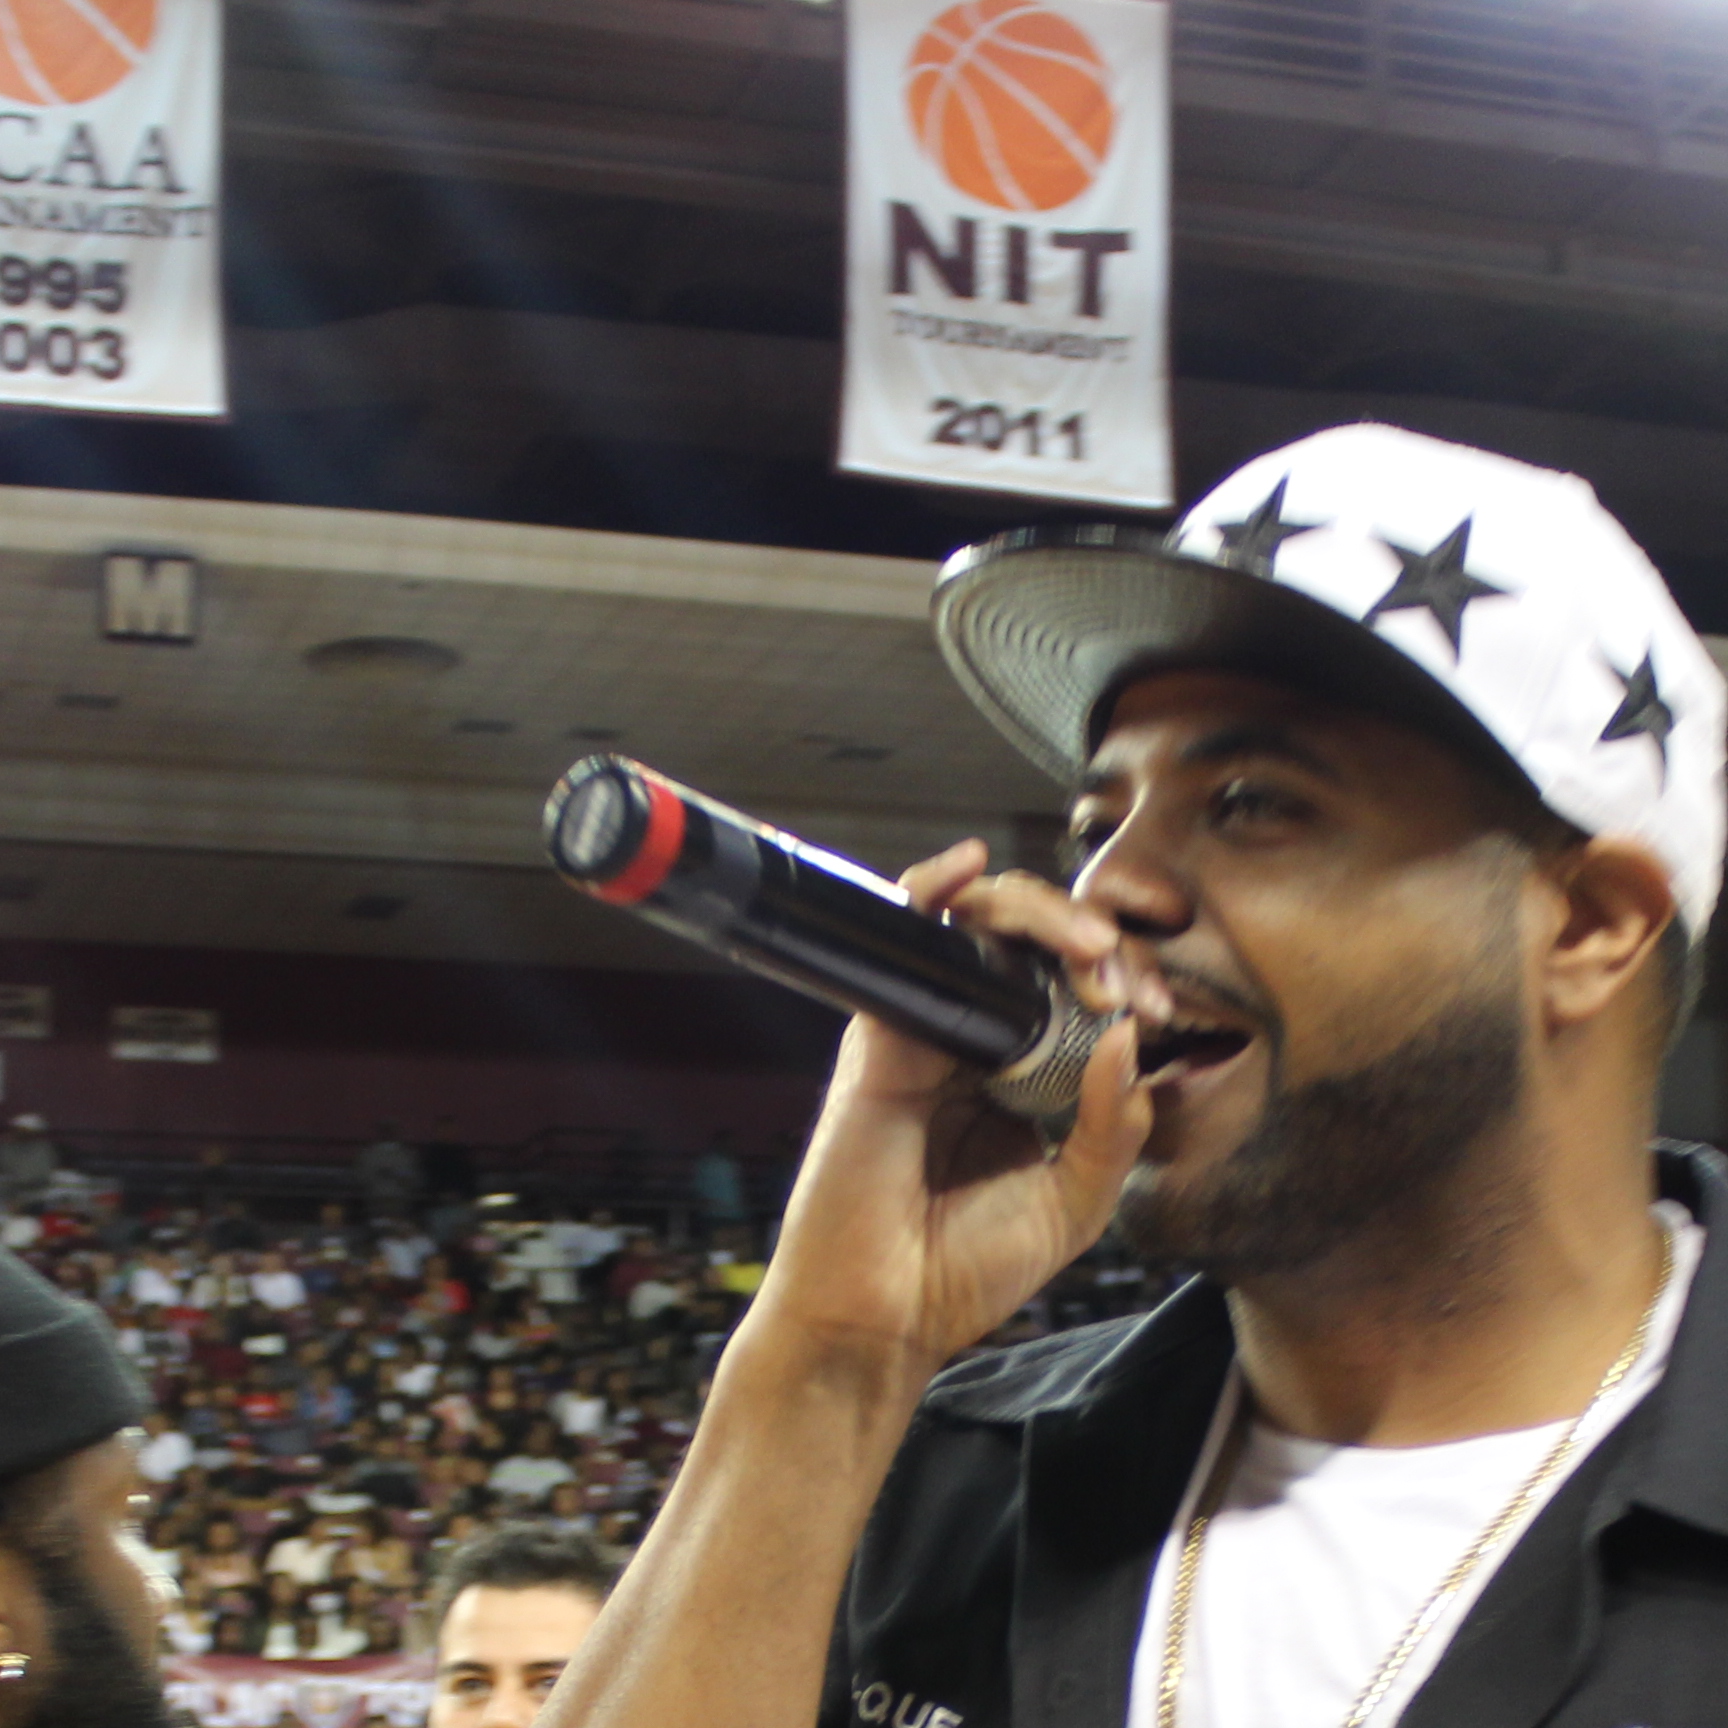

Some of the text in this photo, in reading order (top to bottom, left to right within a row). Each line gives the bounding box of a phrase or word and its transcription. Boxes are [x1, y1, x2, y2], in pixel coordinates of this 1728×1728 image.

[887, 200, 1133, 319] NIT
[929, 398, 1089, 462] 2011
[106, 553, 195, 636] M
